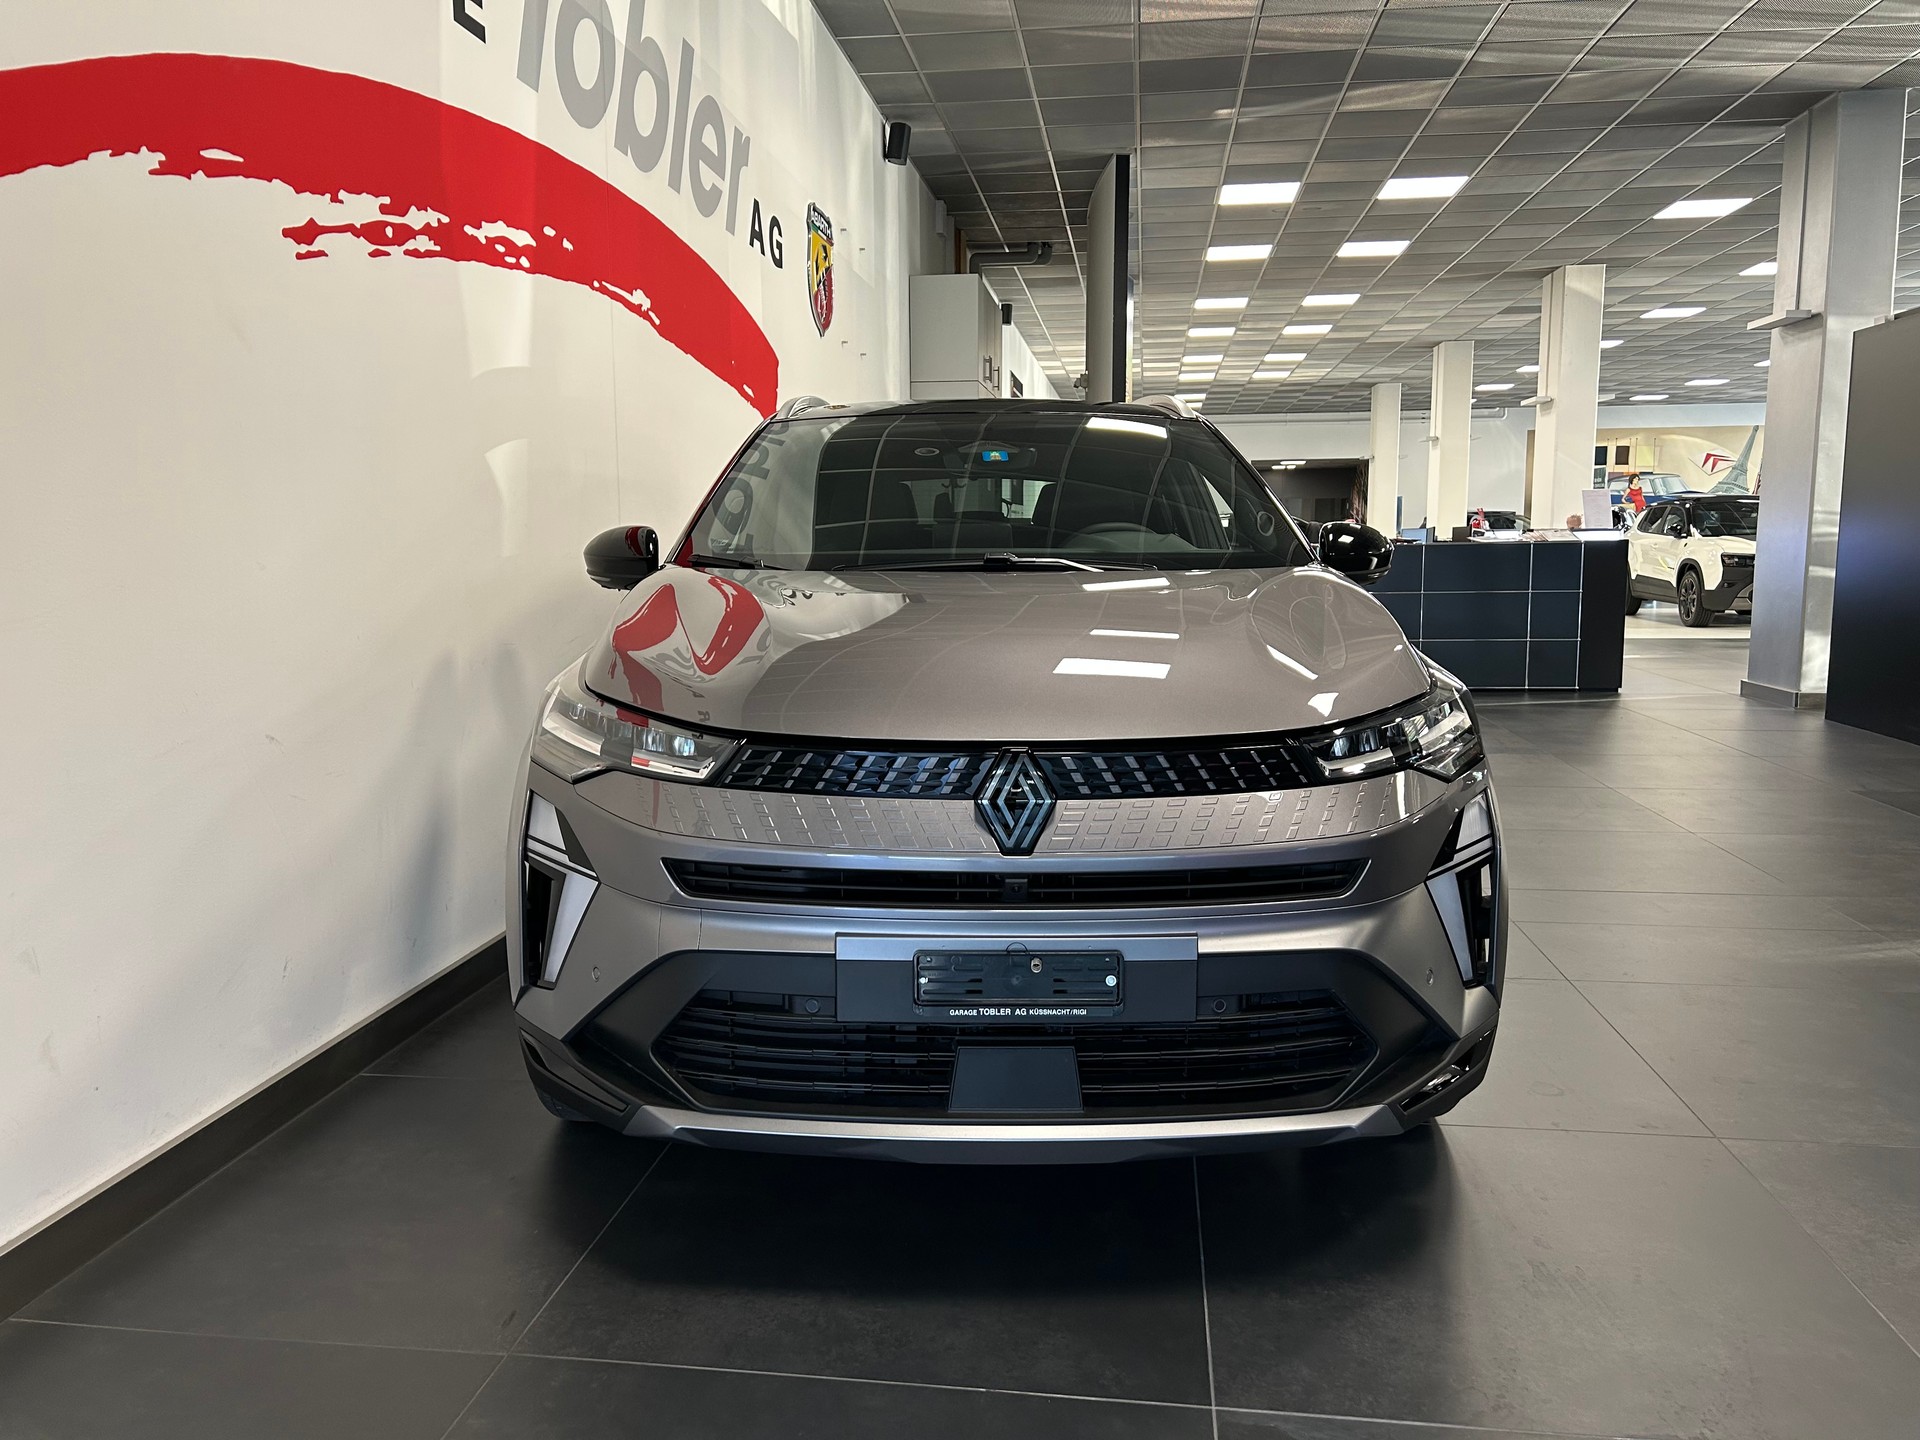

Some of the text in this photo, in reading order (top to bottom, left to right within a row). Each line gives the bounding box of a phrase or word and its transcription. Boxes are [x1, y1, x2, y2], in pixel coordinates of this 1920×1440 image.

[749, 198, 783, 269] AG
[811, 206, 832, 238] ABARTH
[979, 1008, 1012, 1016] TOBLER
[1015, 1008, 1027, 1016] AG
[1029, 1008, 1087, 1016] KÜSSNACHT/RIGI
